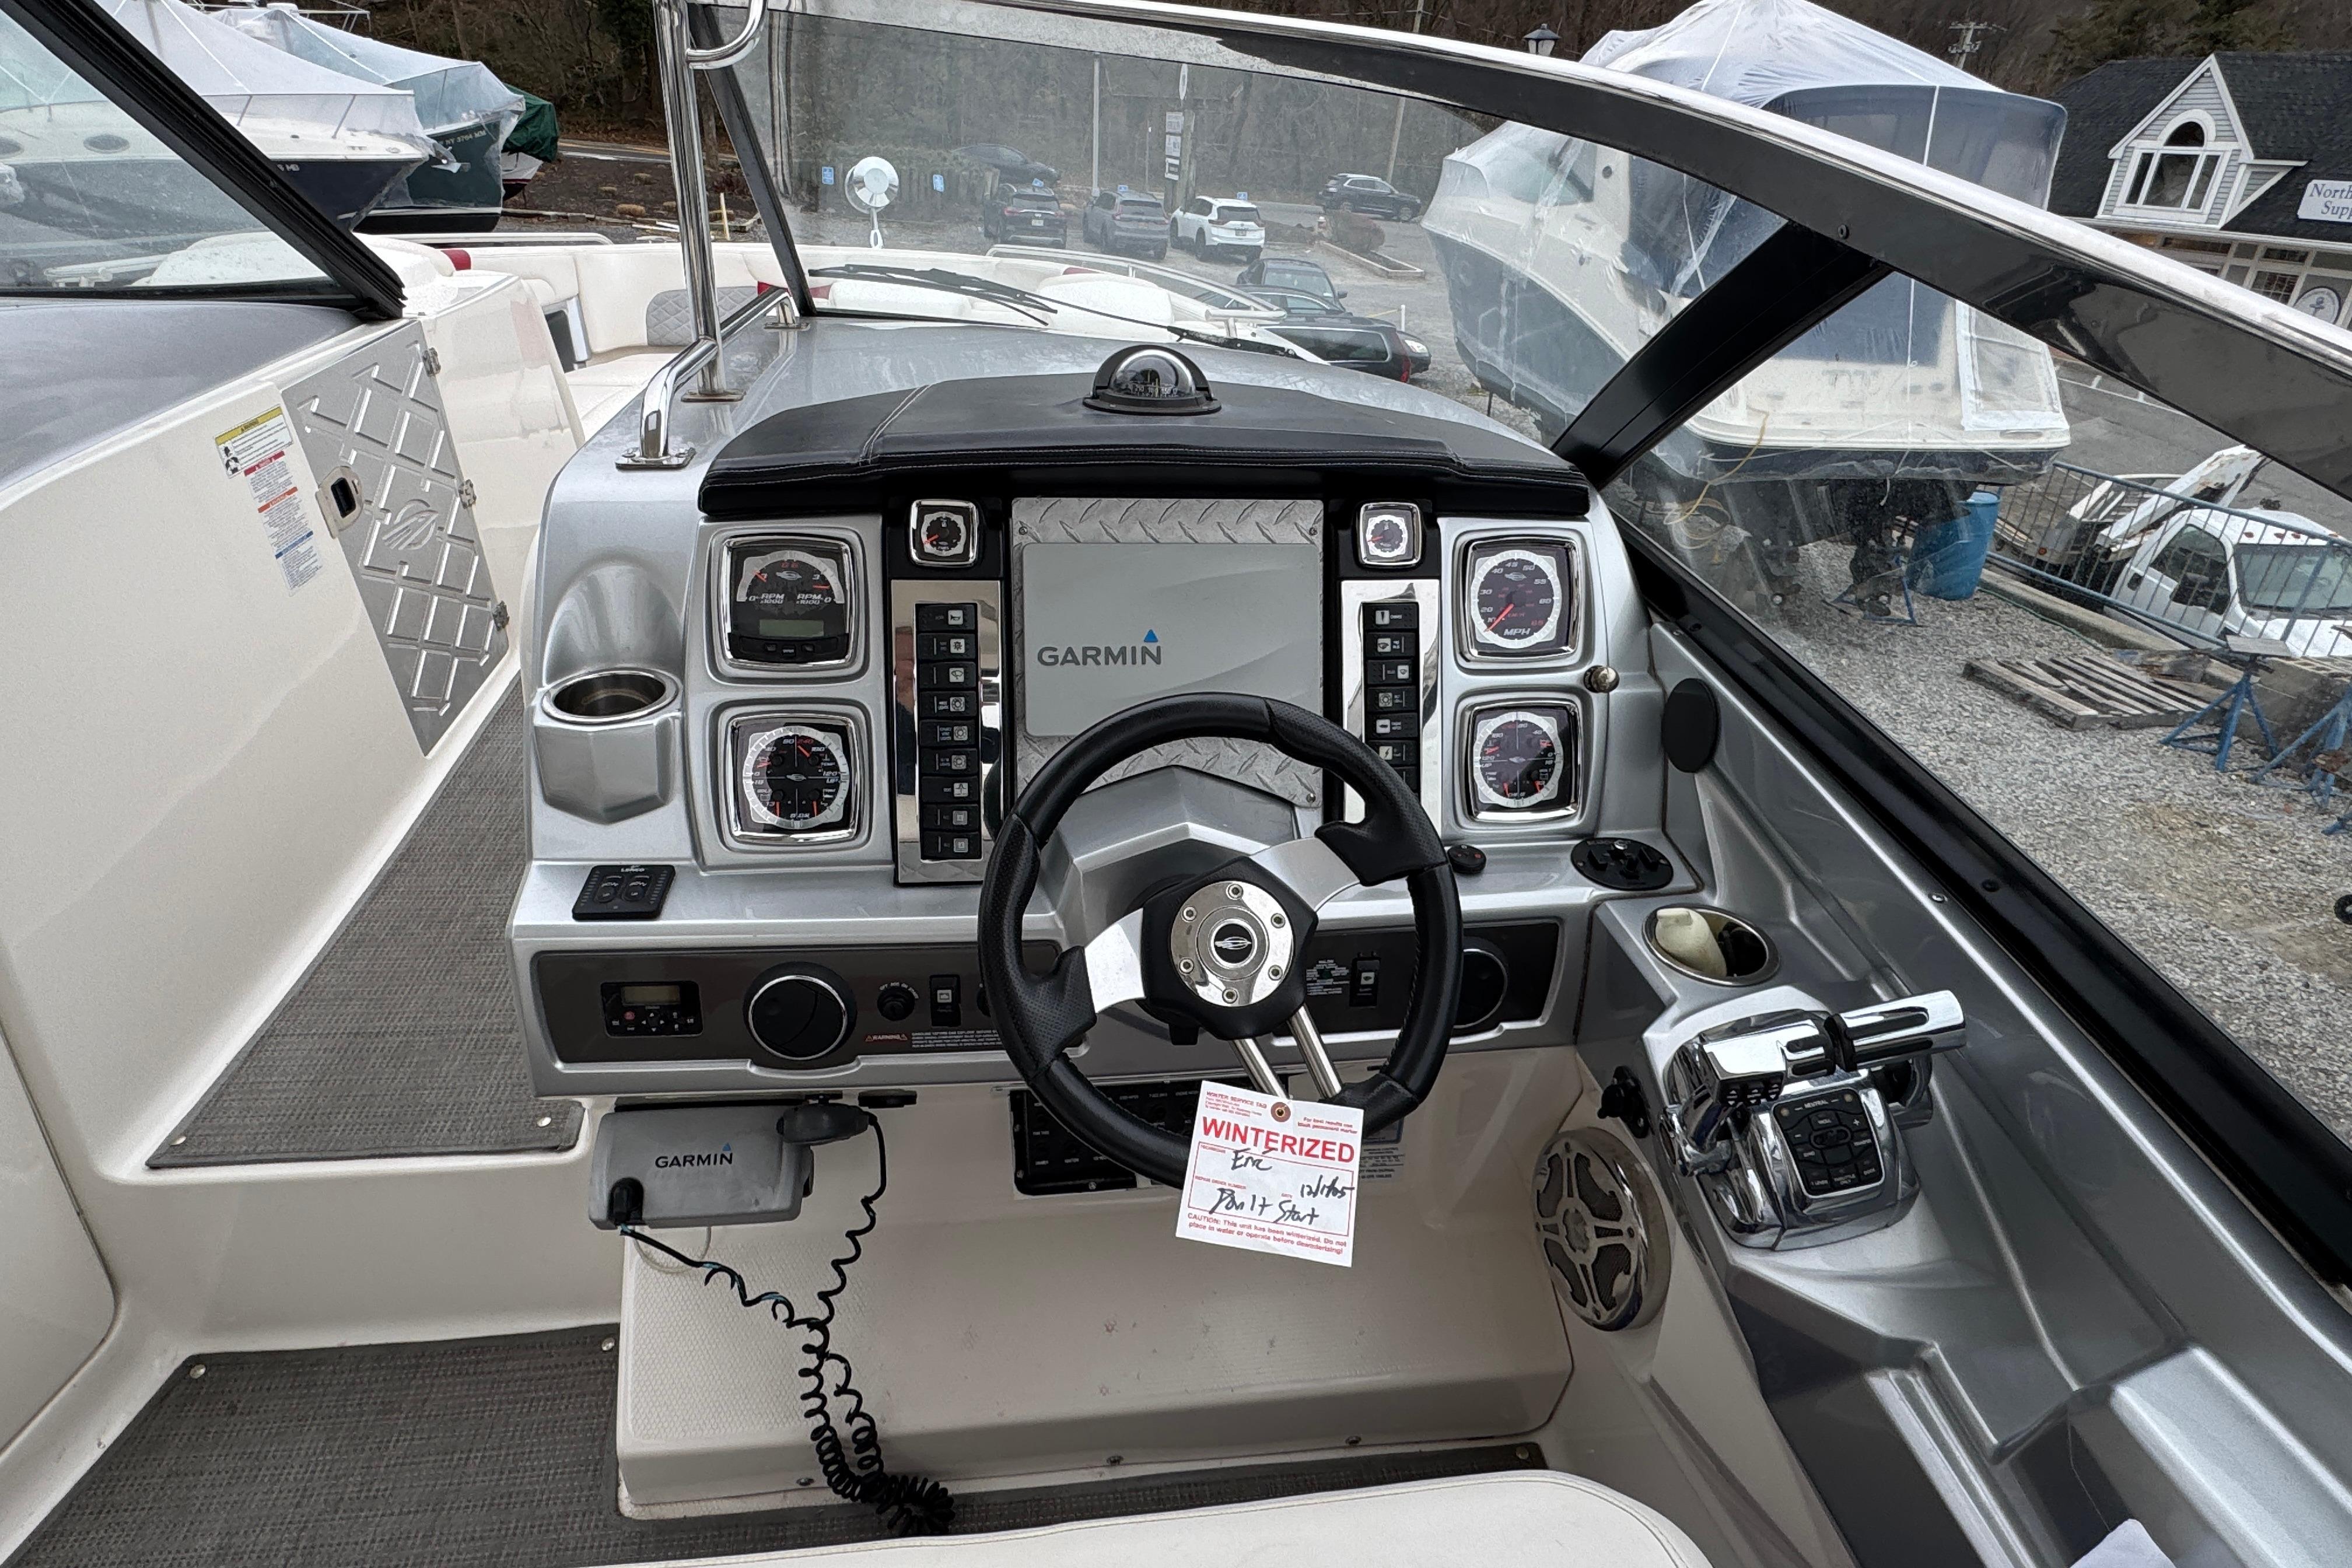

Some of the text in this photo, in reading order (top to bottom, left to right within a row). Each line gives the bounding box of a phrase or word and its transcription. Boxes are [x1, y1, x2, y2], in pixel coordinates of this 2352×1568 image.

[1503, 628, 1531, 636] MPH
[1037, 645, 1162, 666] GARMIN
[1804, 1100, 1829, 1108] NEUTRAL
[1202, 1116, 1354, 1163] WINTERIZED
[654, 1152, 734, 1168] GARMIN
[1188, 1212, 1221, 1224] CAUTION:
[1223, 1219, 1237, 1227] This
[1273, 1199, 1320, 1225] Start
[1189, 1222, 1207, 1230] place
[1216, 1227, 1235, 1235] water
[1273, 1236, 1295, 1245] before
